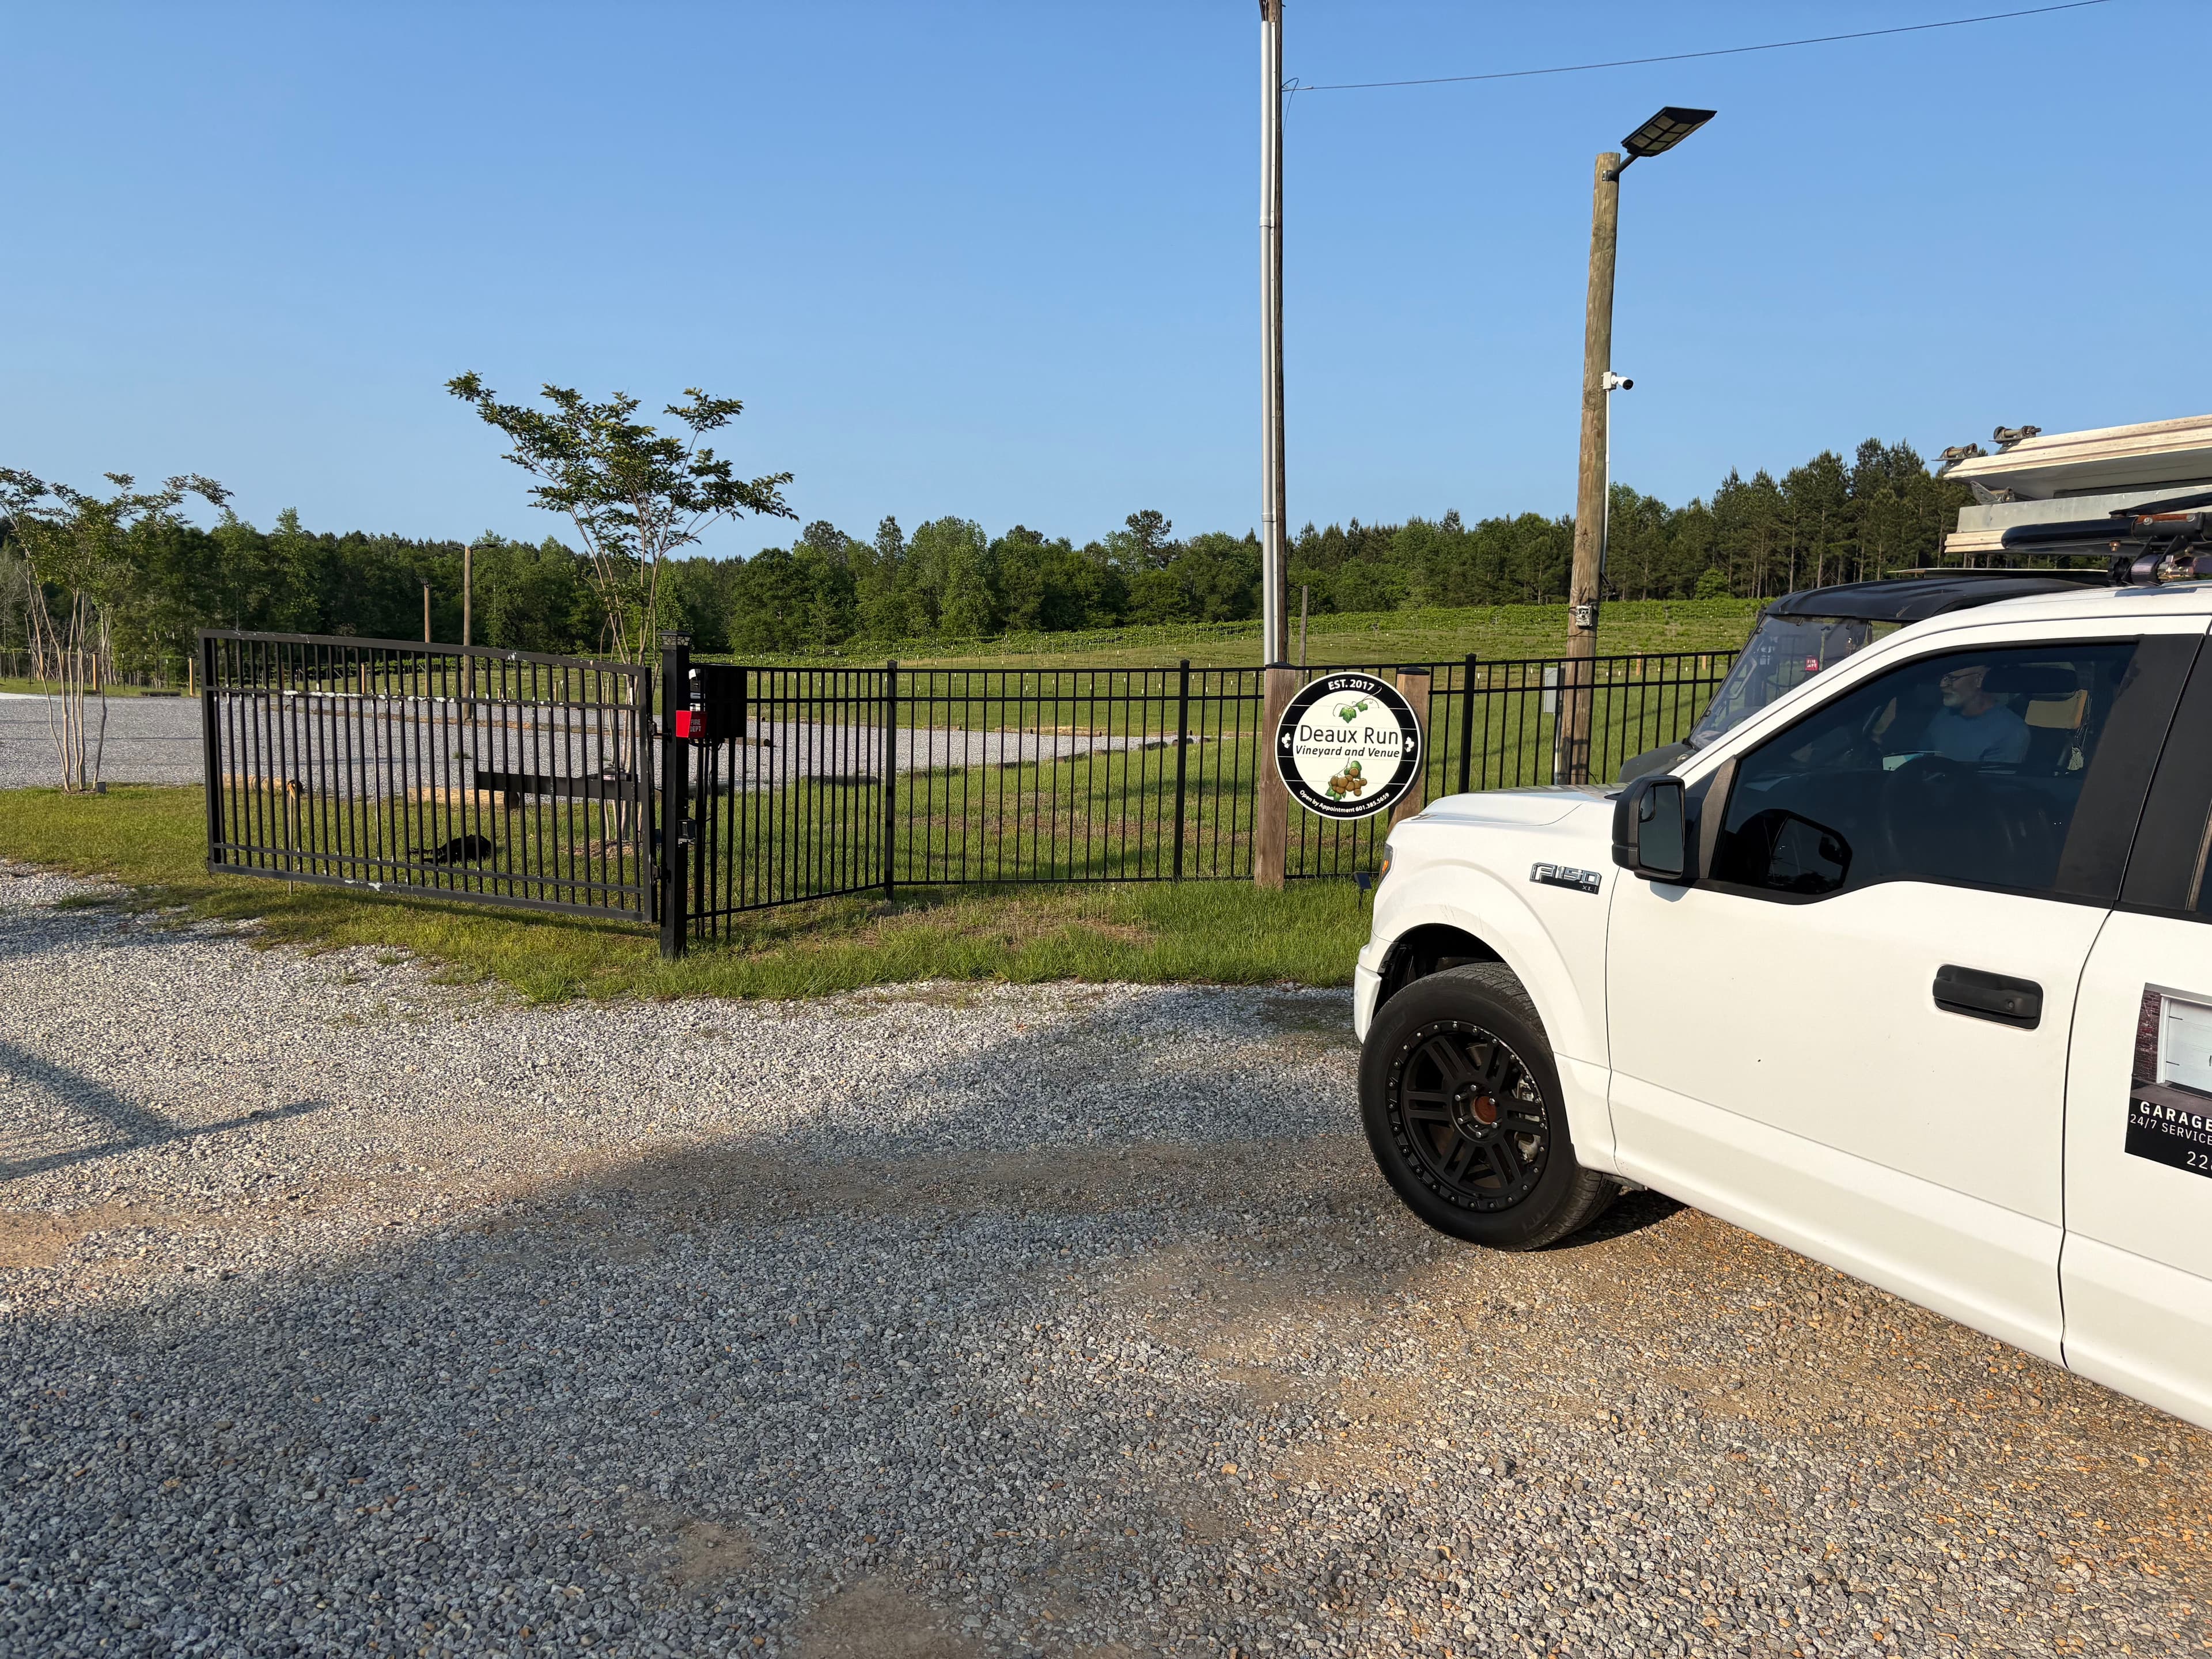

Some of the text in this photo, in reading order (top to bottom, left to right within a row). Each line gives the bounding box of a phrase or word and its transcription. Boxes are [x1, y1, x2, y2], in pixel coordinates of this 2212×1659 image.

[1328, 679, 1375, 691] EST. 2017
[1300, 725, 1398, 745] Deaux Run
[1296, 745, 1400, 757] Vineyard and Venue
[1300, 790, 1313, 802] Open
[1319, 802, 1355, 813] Appointment
[2140, 1101, 2212, 1132] GARAGE
[2130, 1113, 2212, 1146] 24/7 SERVICE
[2187, 1151, 2212, 1171] 22
